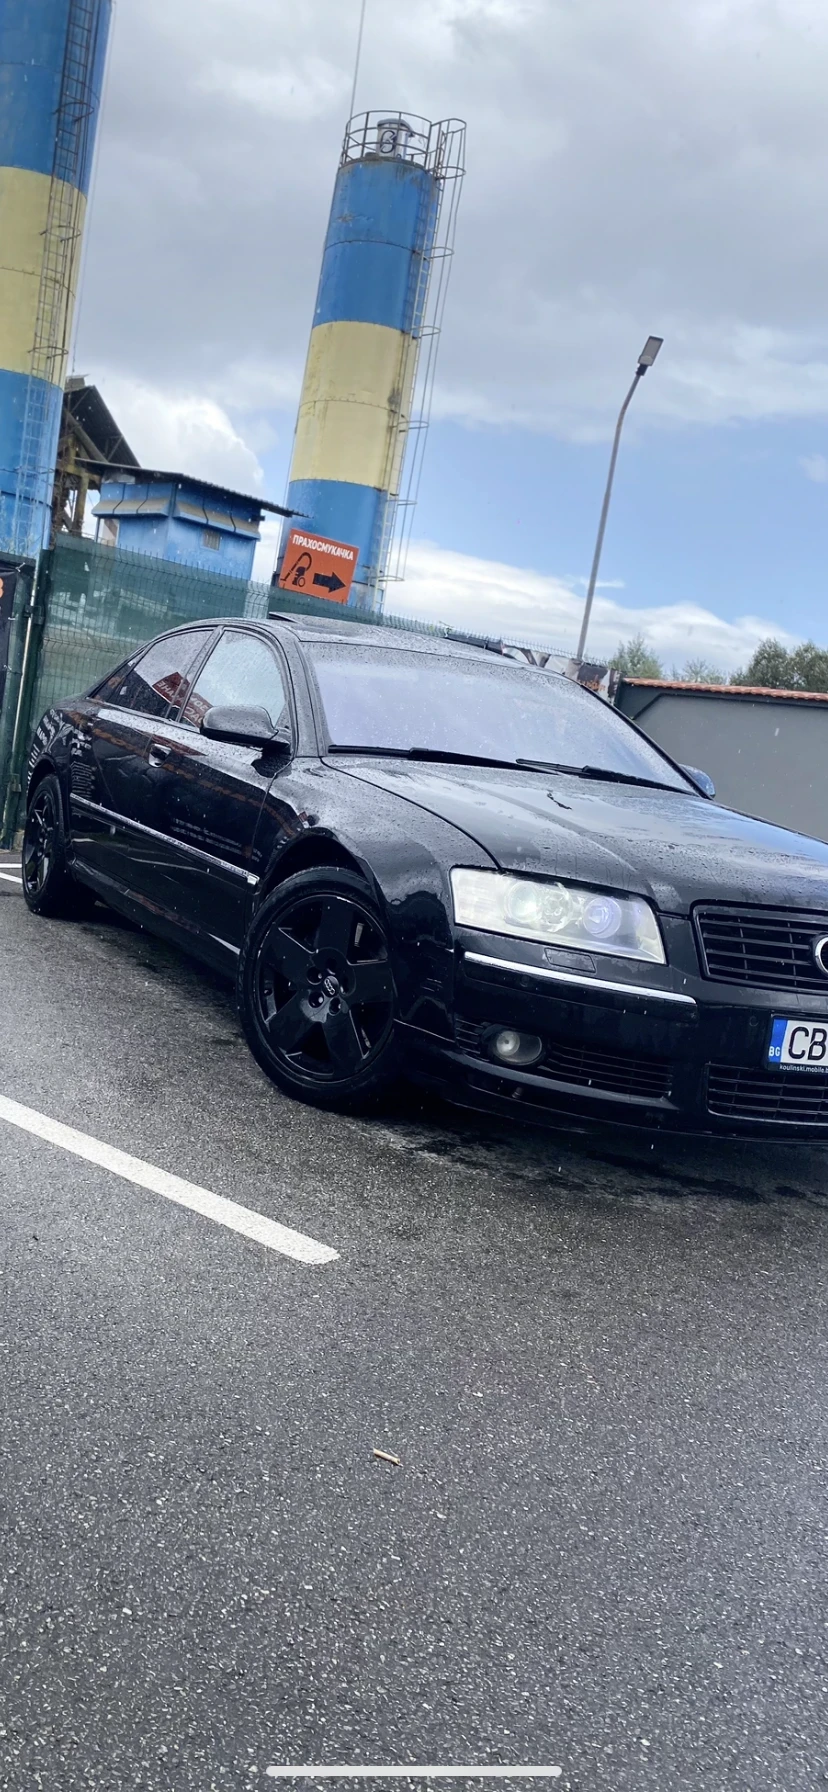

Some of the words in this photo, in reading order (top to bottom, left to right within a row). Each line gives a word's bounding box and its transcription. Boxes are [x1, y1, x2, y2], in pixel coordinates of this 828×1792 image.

[292, 534, 354, 560] ПРАХОСМУКАЧКА
[768, 1046, 780, 1057] BG
[788, 1026, 828, 1061] CB
